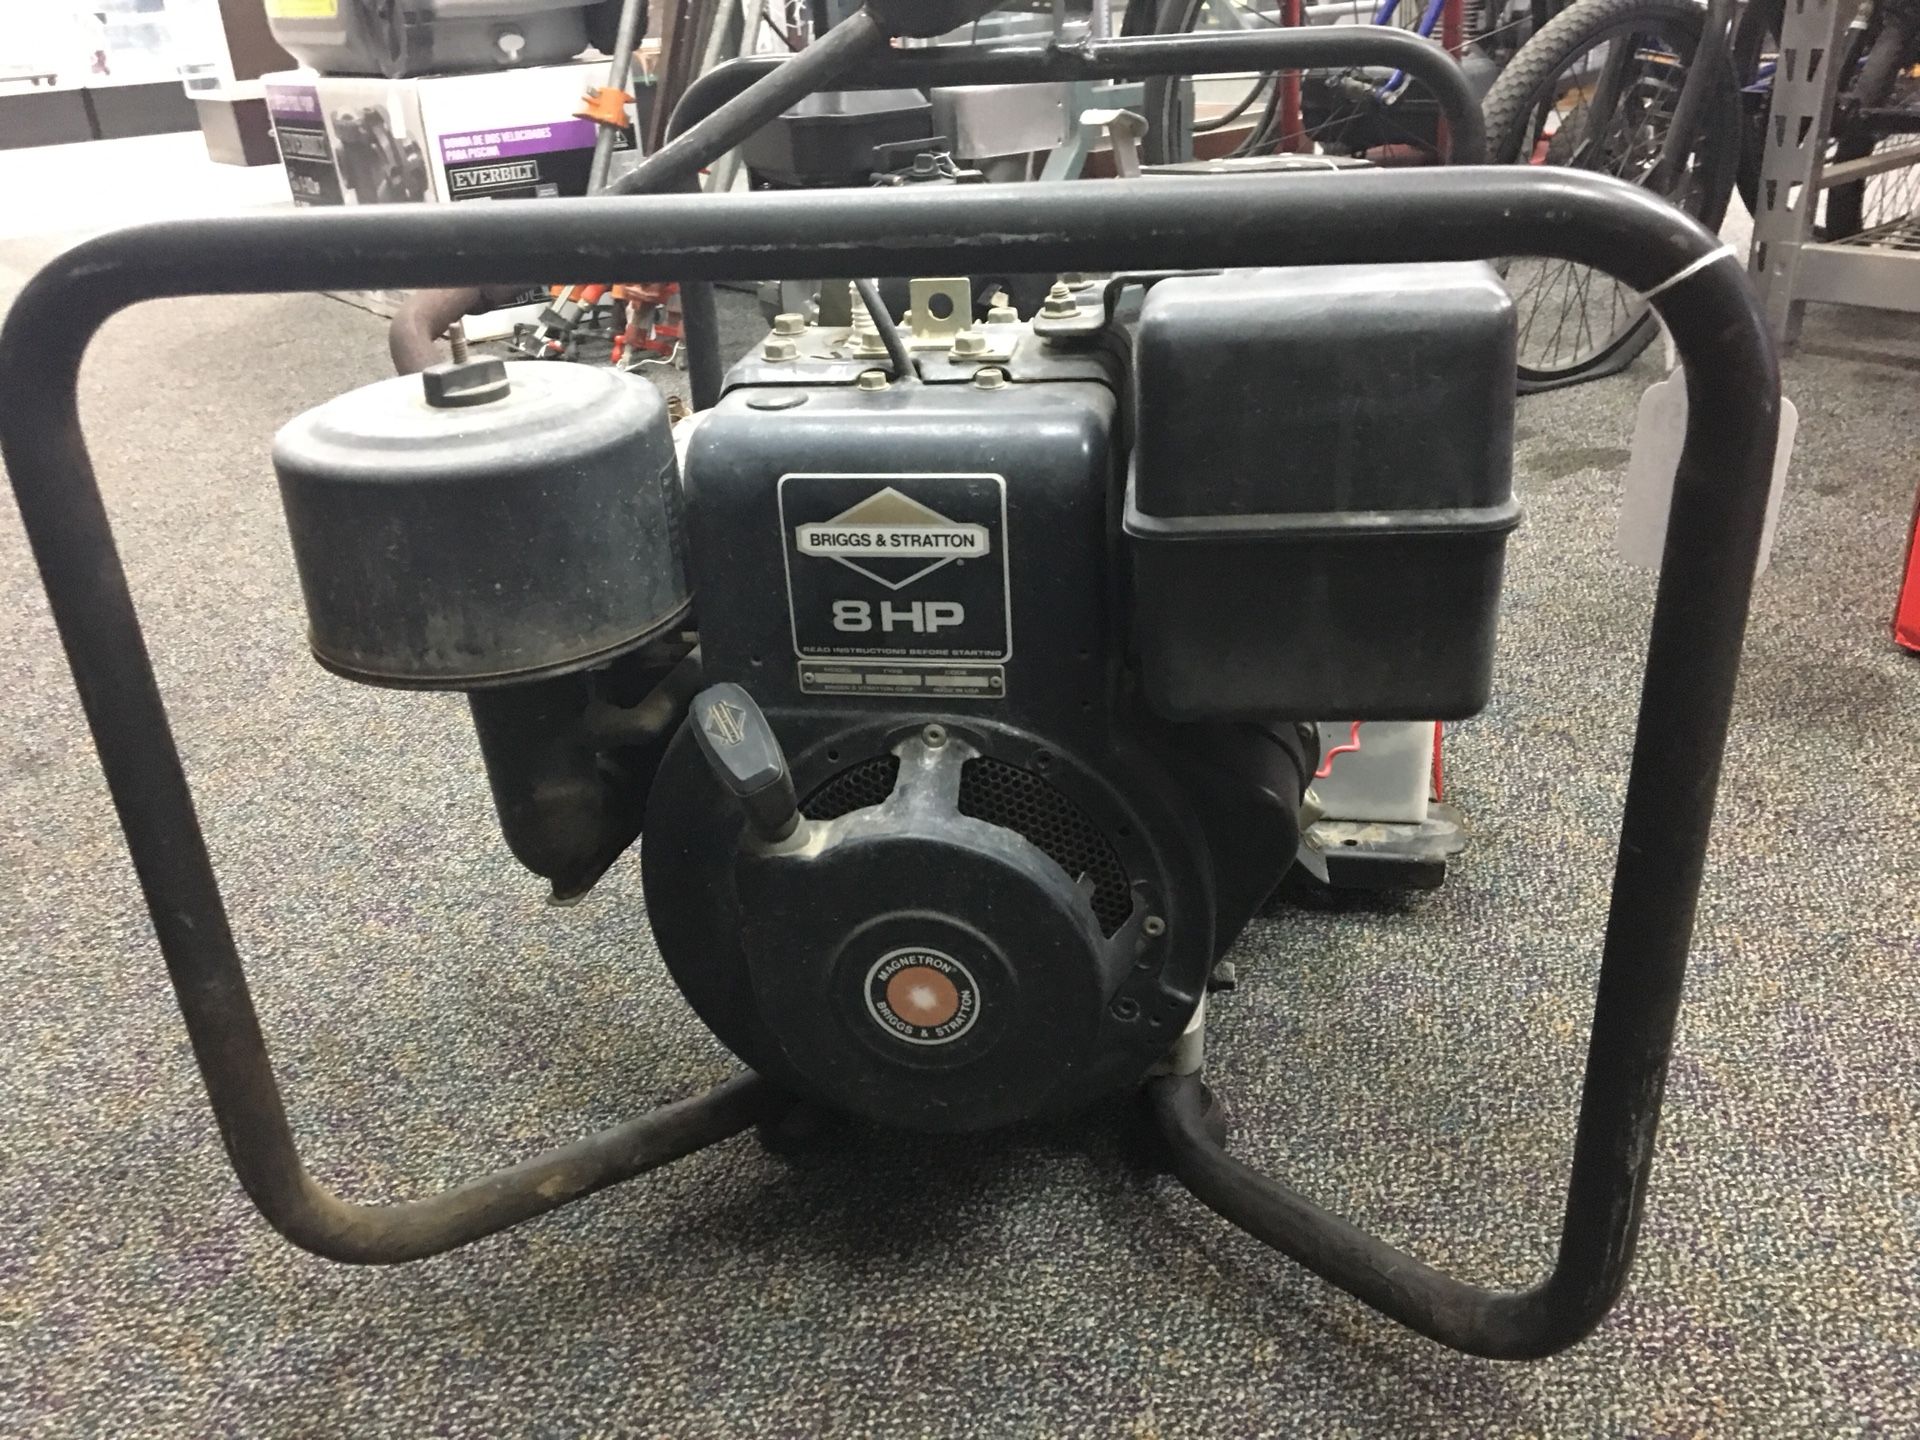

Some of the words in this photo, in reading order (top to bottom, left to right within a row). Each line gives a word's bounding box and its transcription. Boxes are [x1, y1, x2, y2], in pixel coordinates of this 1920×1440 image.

[454, 164, 534, 187] EVERBILT
[810, 533, 871, 547] BRIGGS
[876, 534, 887, 547] &
[890, 533, 976, 548] STRATTON
[832, 600, 872, 632] 8
[880, 601, 965, 633] HP
[833, 647, 906, 655] INSTRUCTIONS
[909, 648, 949, 656] BEFORE
[952, 649, 1002, 657] STARTING
[878, 955, 952, 981] MAGNETRON
[877, 1001, 914, 1034] BRIGGS
[920, 1029, 928, 1037] &
[935, 990, 972, 1037] STRATTON
